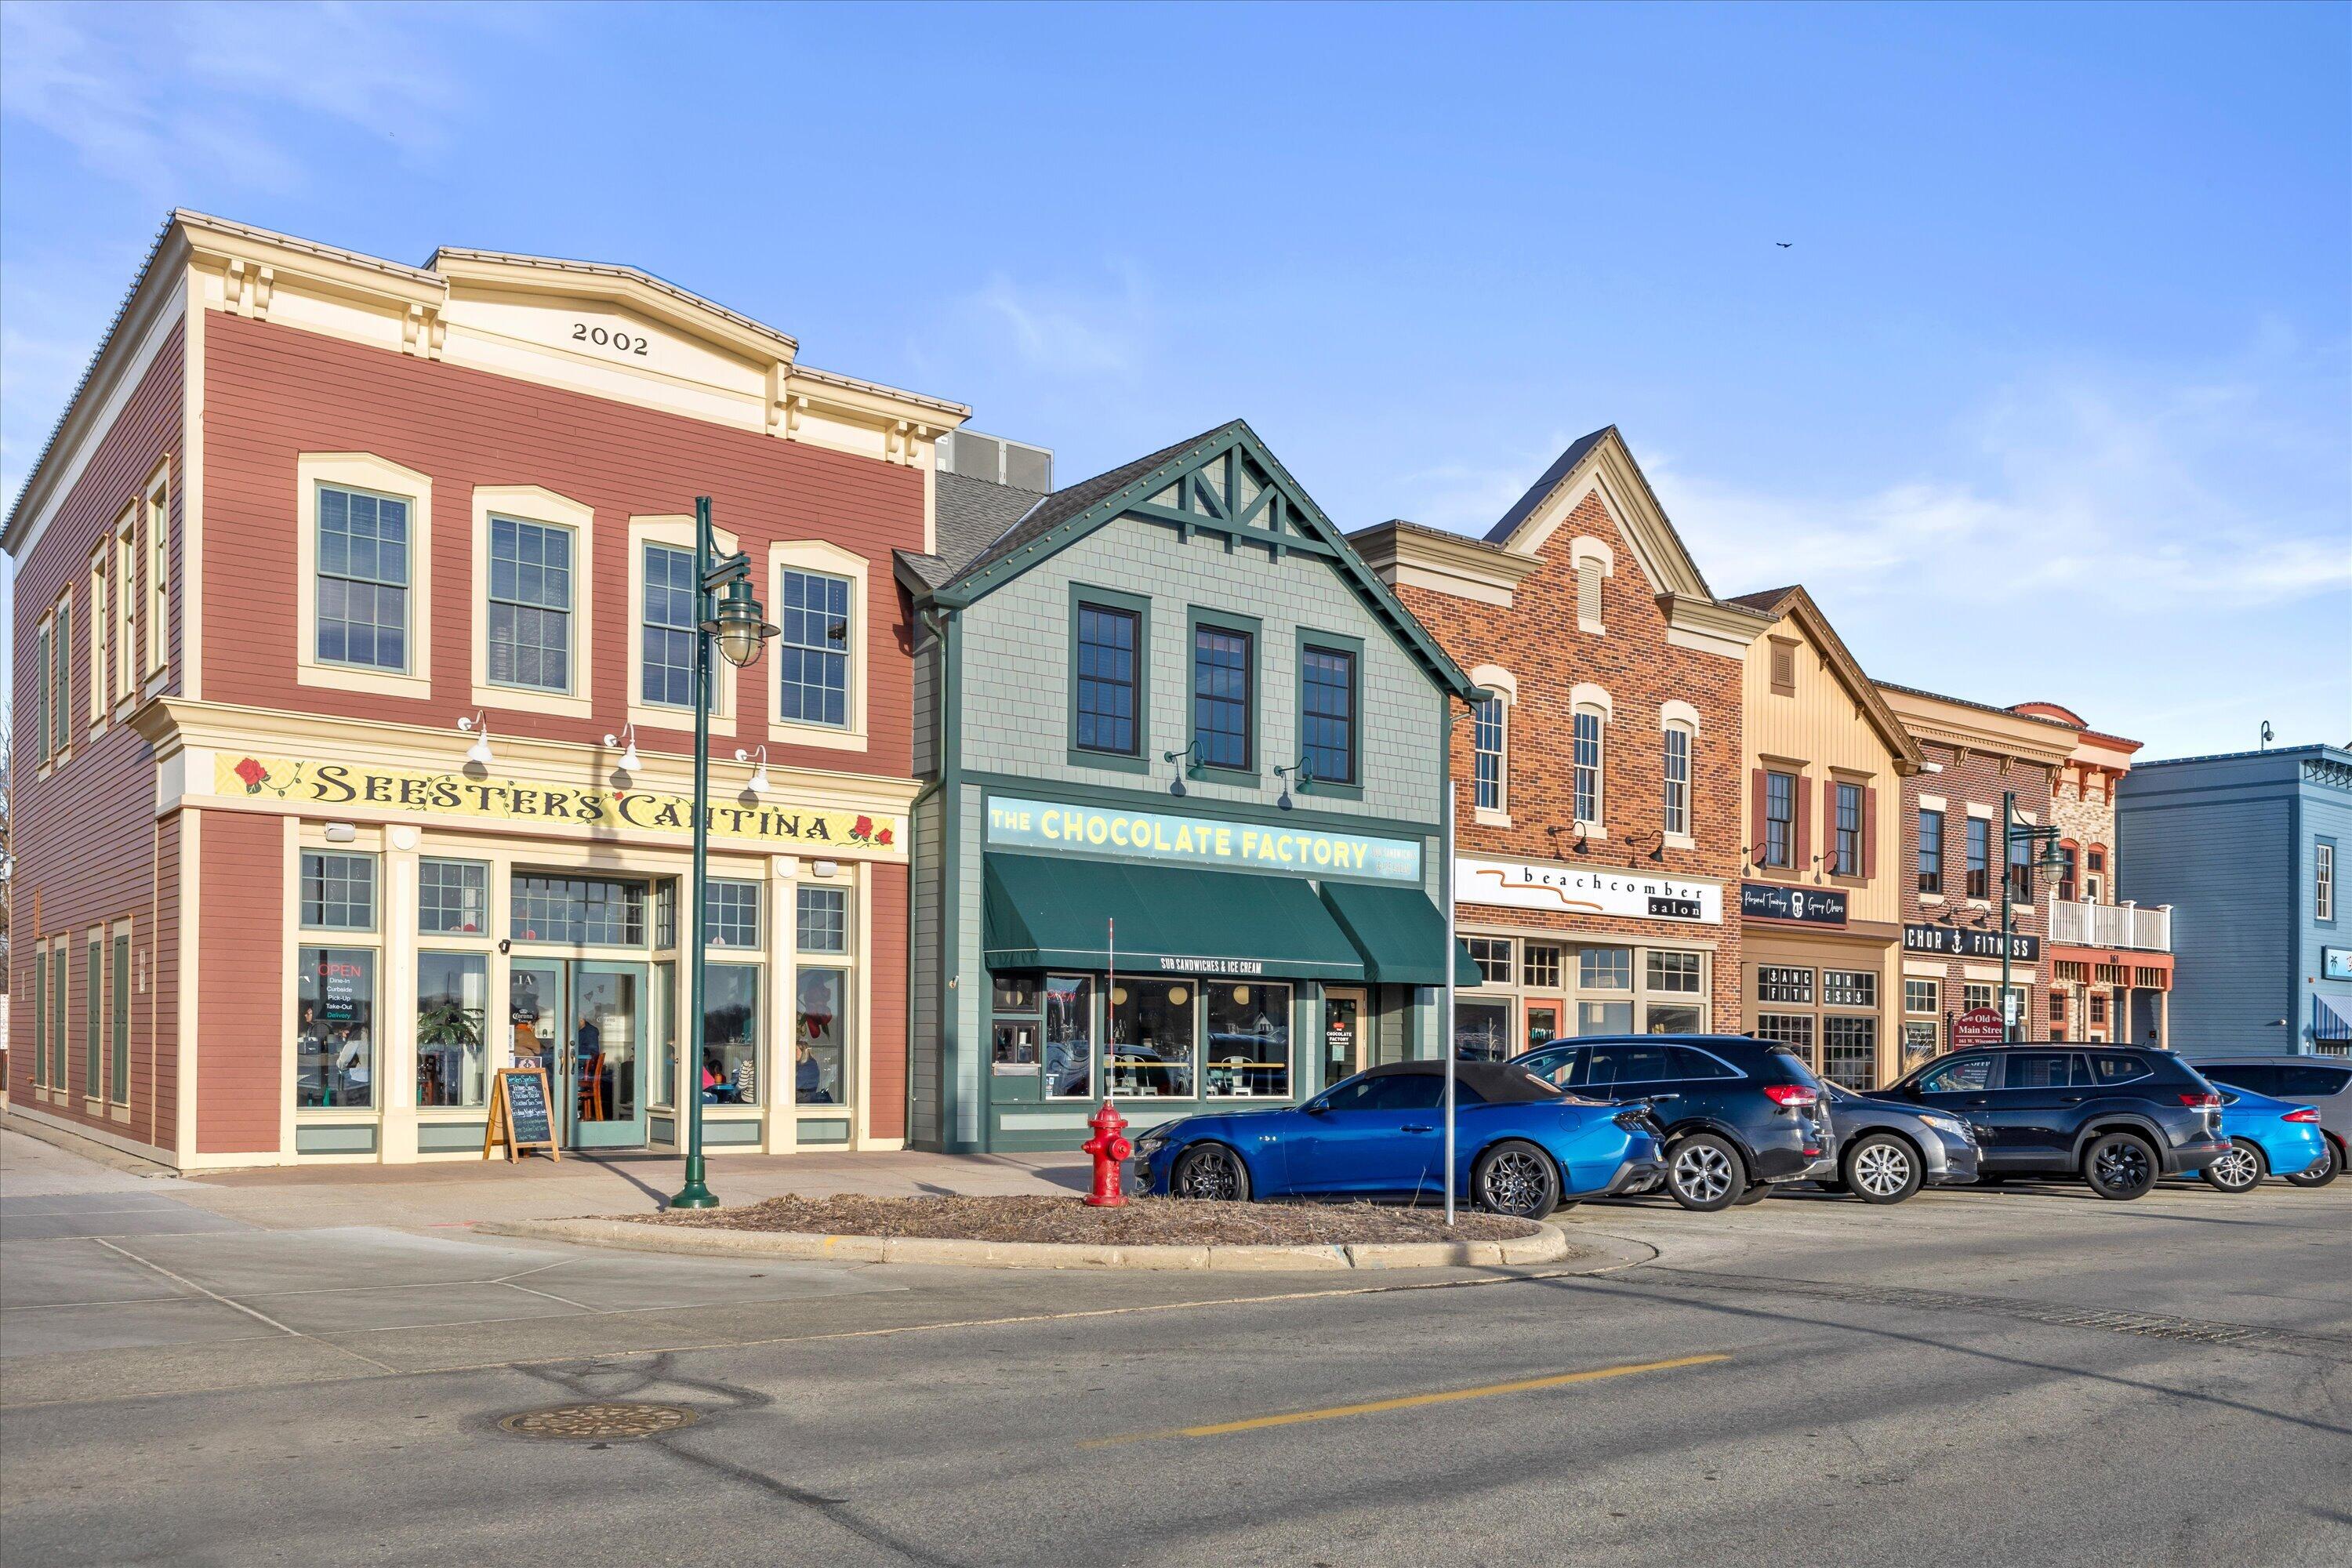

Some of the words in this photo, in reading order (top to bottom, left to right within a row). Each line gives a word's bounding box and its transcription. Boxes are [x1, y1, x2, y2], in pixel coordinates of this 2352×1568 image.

[572, 323, 648, 356] 2002
[991, 809, 1030, 830] THE
[1040, 809, 1232, 856] CHOCOLATE
[1243, 831, 1368, 869] FACTORY
[1524, 867, 1702, 899] beachcomber
[1651, 902, 1700, 916] salon
[1744, 891, 1766, 906] Personal
[1766, 892, 1788, 912] Training
[1808, 897, 1825, 916] Group
[1825, 898, 1844, 914] Classes
[1904, 928, 1942, 949] CHOR
[1974, 935, 2028, 956] FITNSS
[1160, 957, 1175, 969] SUB
[1176, 958, 1219, 972] SANDWICHES
[1221, 960, 1226, 972] &
[1228, 961, 1239, 973] ICE
[1240, 962, 1262, 974] CREAM
[2110, 954, 2119, 964] 161
[318, 964, 361, 978] OPEN
[517, 975, 532, 985] 1A
[1975, 1014, 1990, 1022] Old
[1982, 1025, 2003, 1034] Stree
